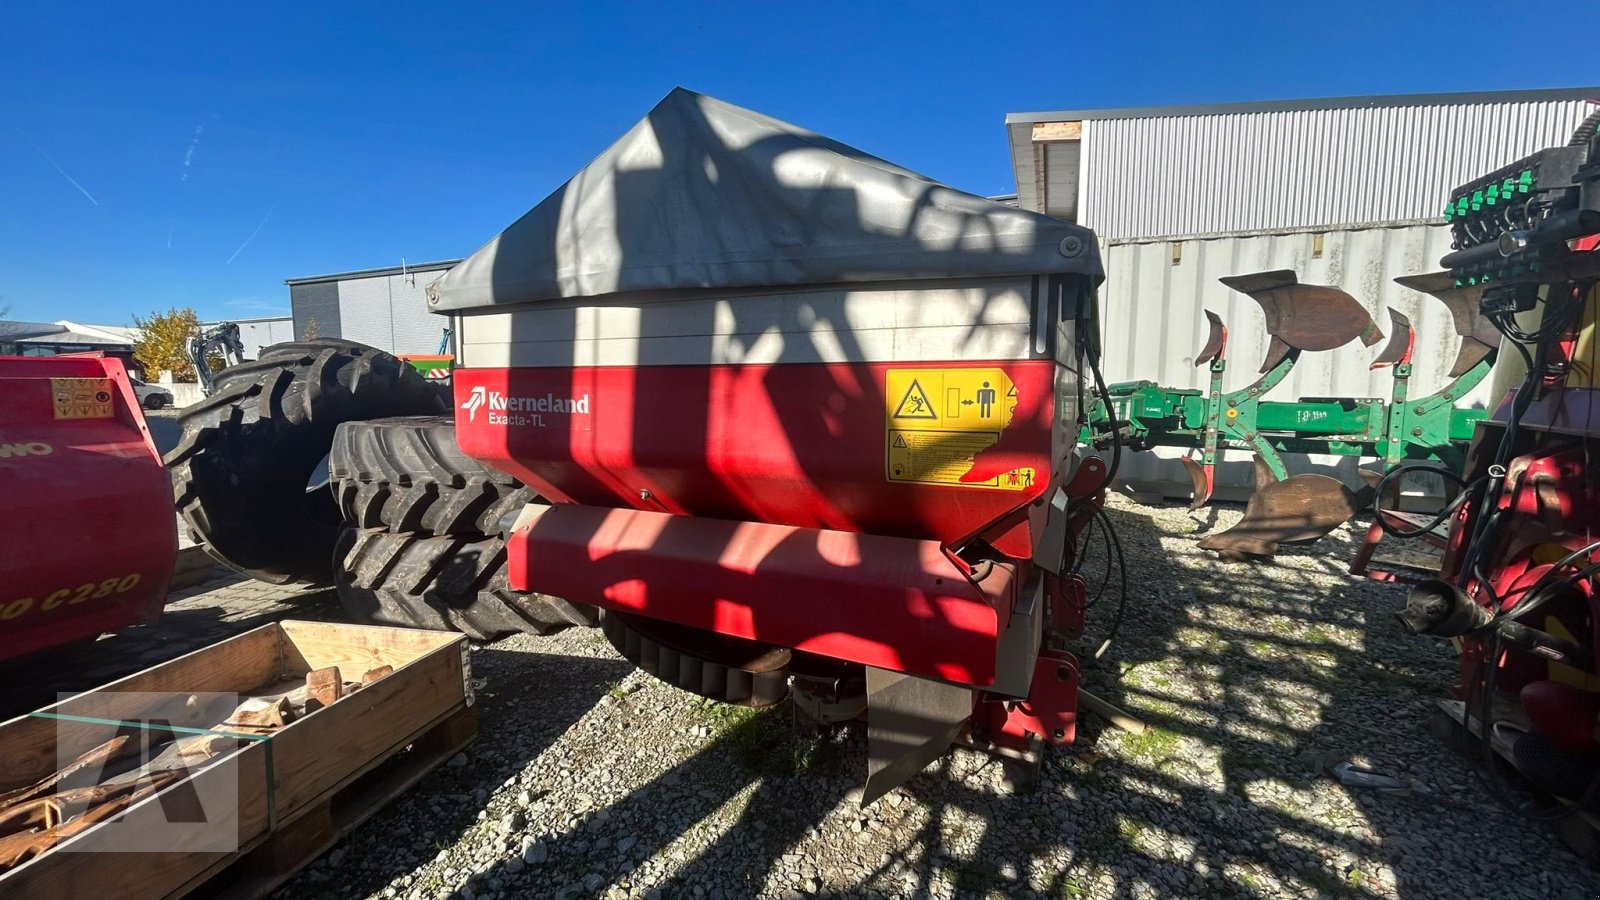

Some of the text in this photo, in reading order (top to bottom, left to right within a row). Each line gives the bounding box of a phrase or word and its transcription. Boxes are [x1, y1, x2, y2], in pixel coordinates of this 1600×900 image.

[488, 391, 590, 414] Kverneland
[488, 412, 546, 427] Exacta-TL
[41, 573, 141, 610] C280
